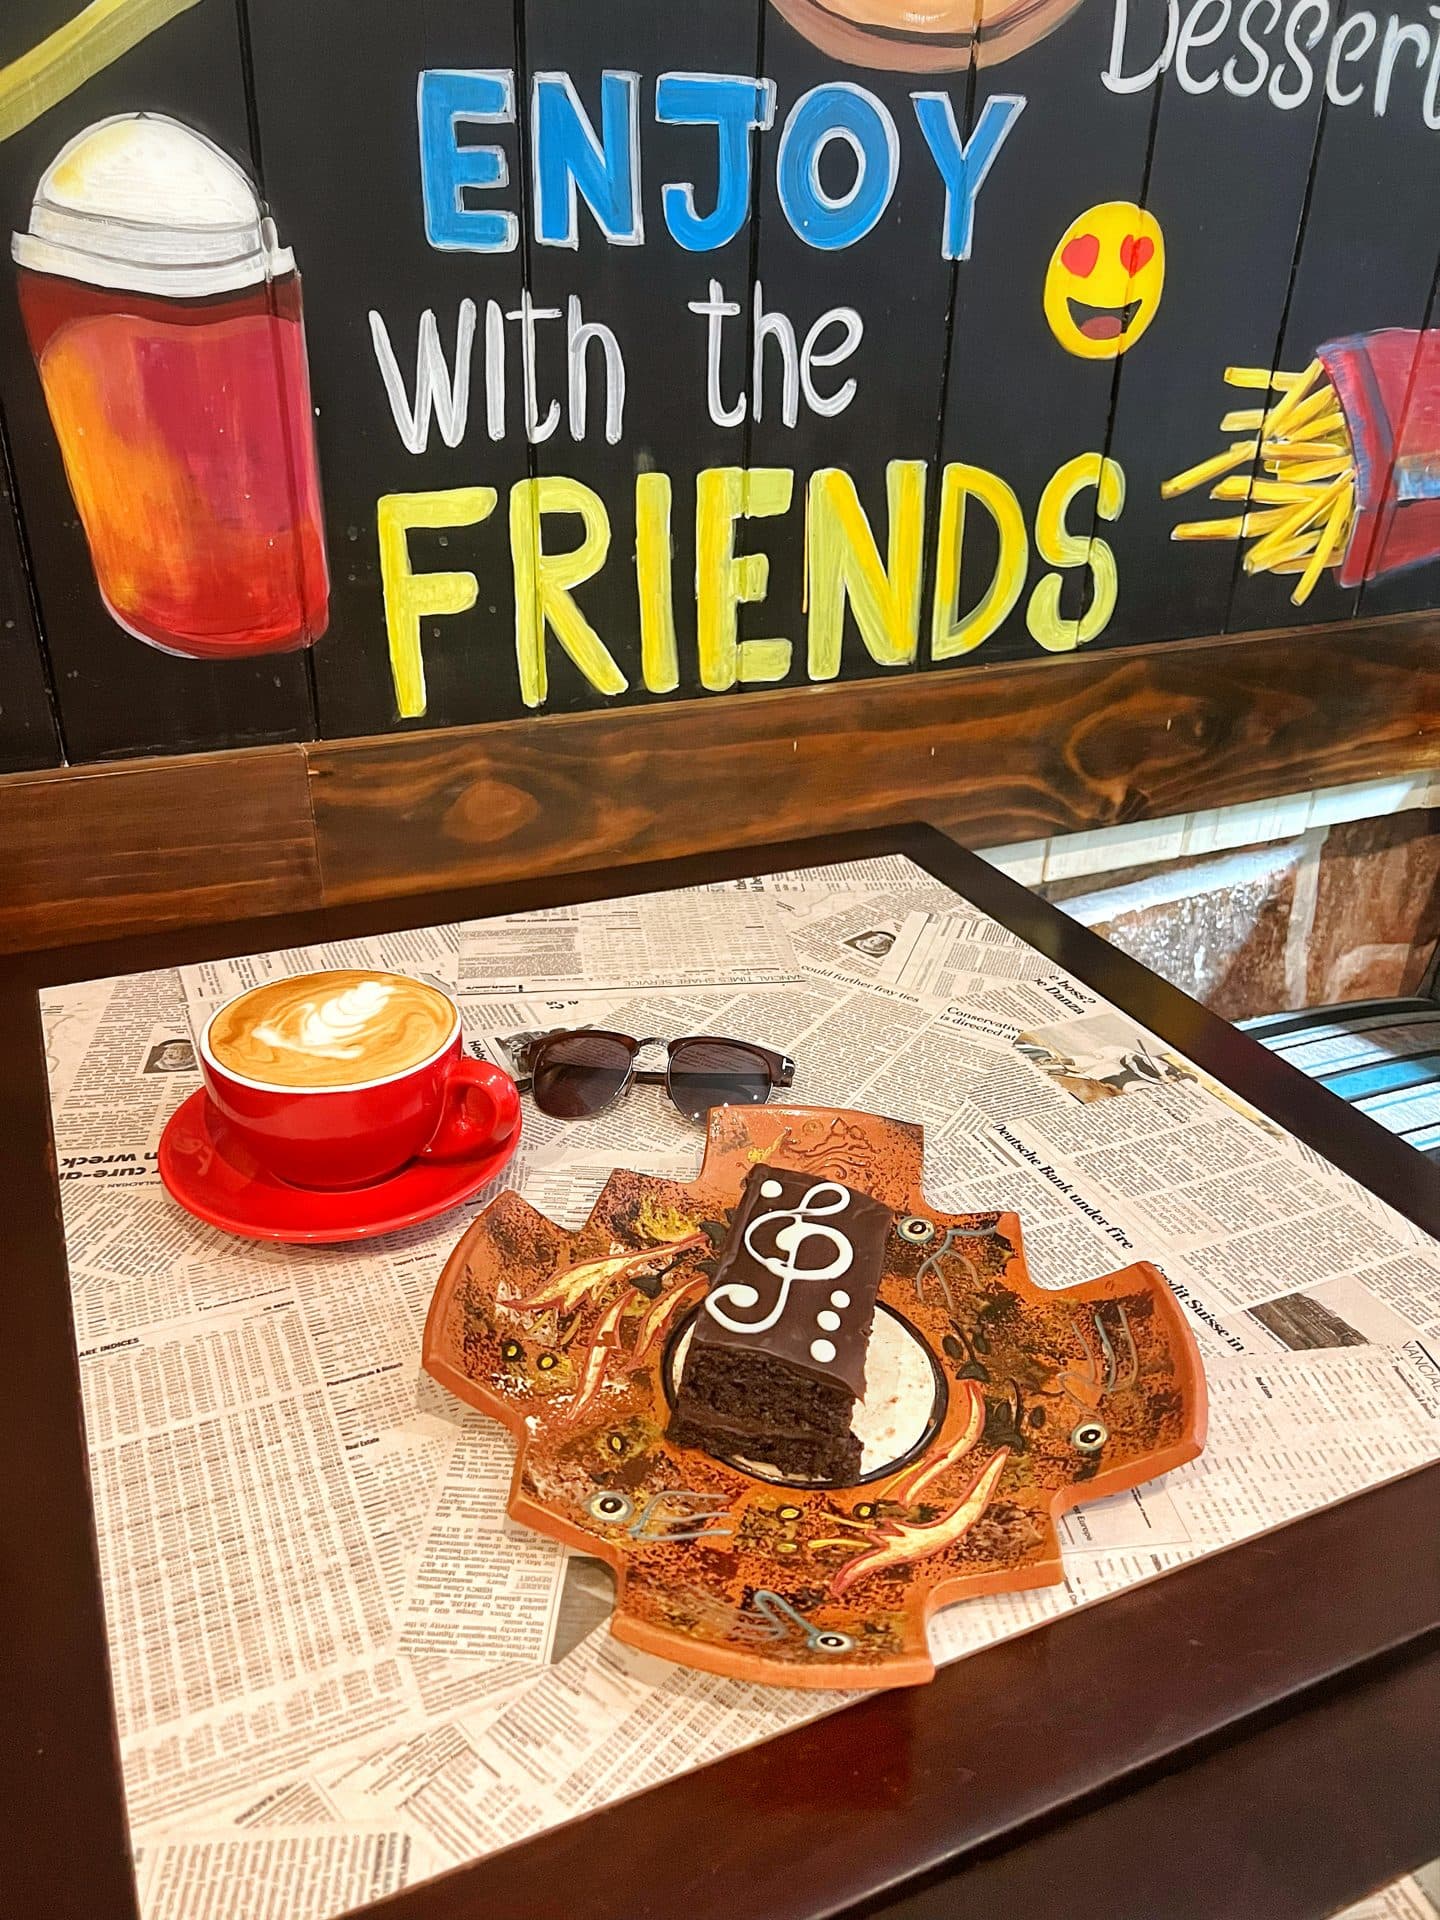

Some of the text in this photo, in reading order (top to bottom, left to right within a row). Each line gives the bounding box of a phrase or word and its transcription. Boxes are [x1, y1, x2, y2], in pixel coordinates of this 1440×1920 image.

[417, 67, 1028, 262] ENJOY
[688, 279, 865, 430] the
[376, 450, 1127, 720] FRIENDS
[801, 966, 833, 976] could
[833, 973, 871, 988] further
[899, 993, 919, 1002] ties
[1044, 987, 1085, 1014] Danza
[1057, 980, 1096, 1003] boss?
[940, 1013, 950, 1021] is
[952, 1018, 1003, 1036] directed
[59, 1153, 136, 1168] wreck
[992, 1121, 1041, 1165] Deutsche
[1038, 1165, 1073, 1193] Bank
[1069, 1194, 1109, 1225] under
[1105, 1227, 1133, 1248] fire
[99, 1337, 139, 1351] INDICES
[1185, 1298, 1228, 1338] Suisse
[1225, 1333, 1247, 1354] in
